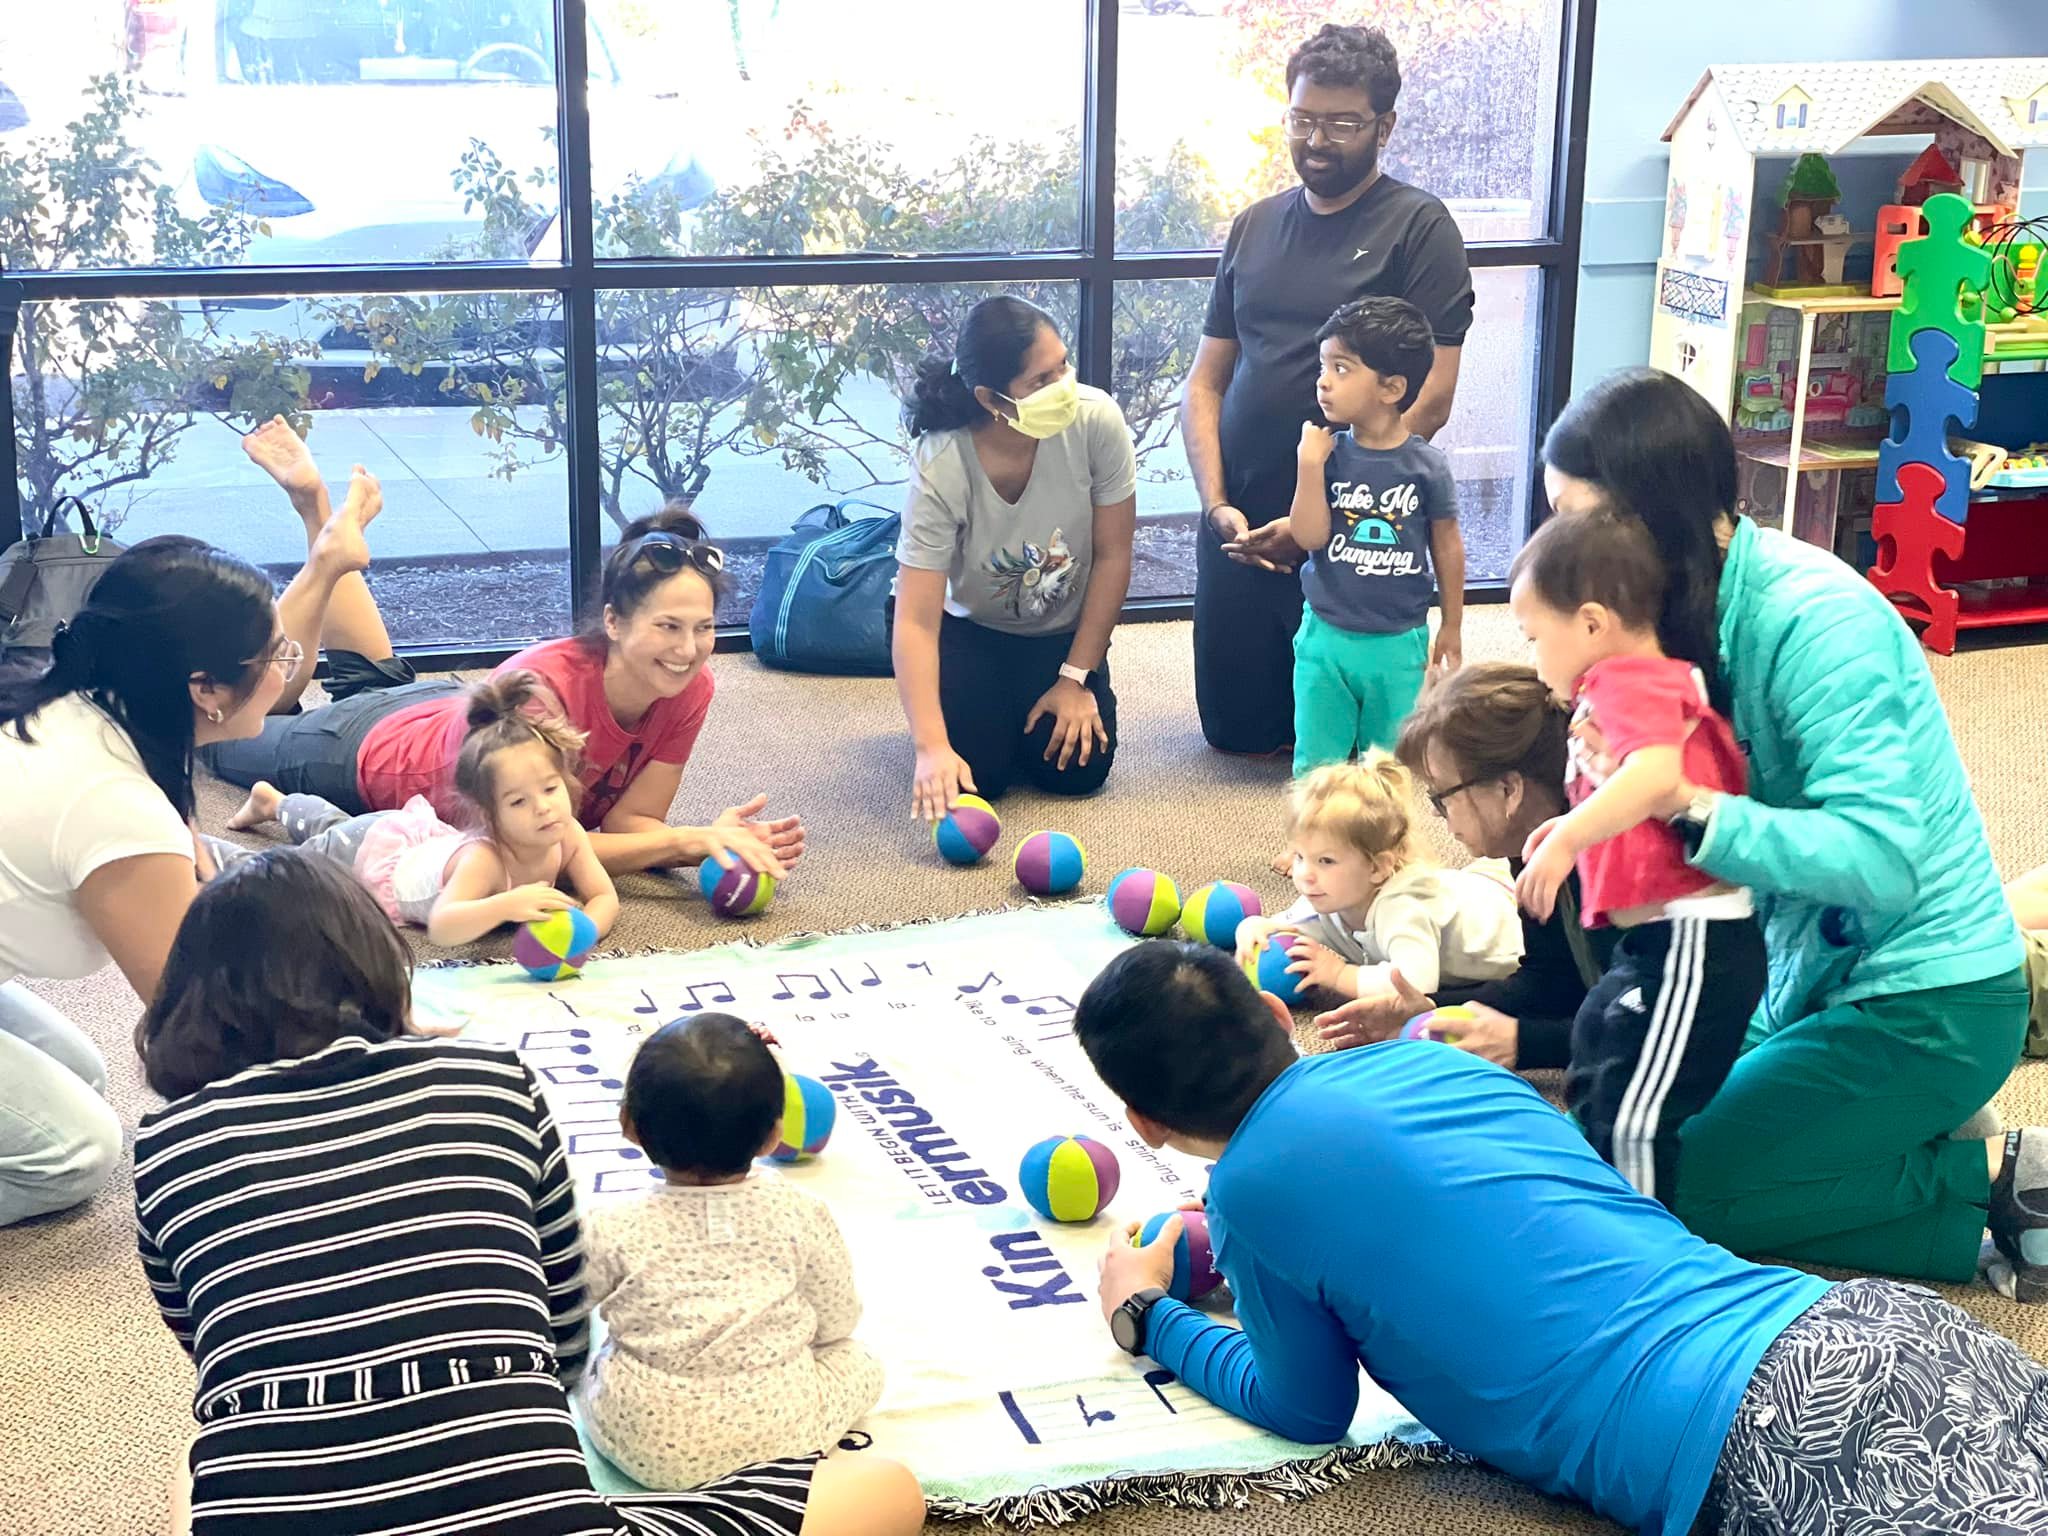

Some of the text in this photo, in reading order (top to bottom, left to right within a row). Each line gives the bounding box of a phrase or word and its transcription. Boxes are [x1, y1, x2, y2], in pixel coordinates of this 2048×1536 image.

[1331, 481, 1419, 515] Take Me
[1327, 533, 1422, 576] Camping
[1001, 1035, 1032, 1056] sing
[1030, 1059, 1065, 1085] when
[1060, 1085, 1086, 1101] the
[1082, 1102, 1110, 1121] sun
[1105, 1121, 1123, 1132] is
[836, 1095, 952, 1205] LET IT BEGIN WITH
